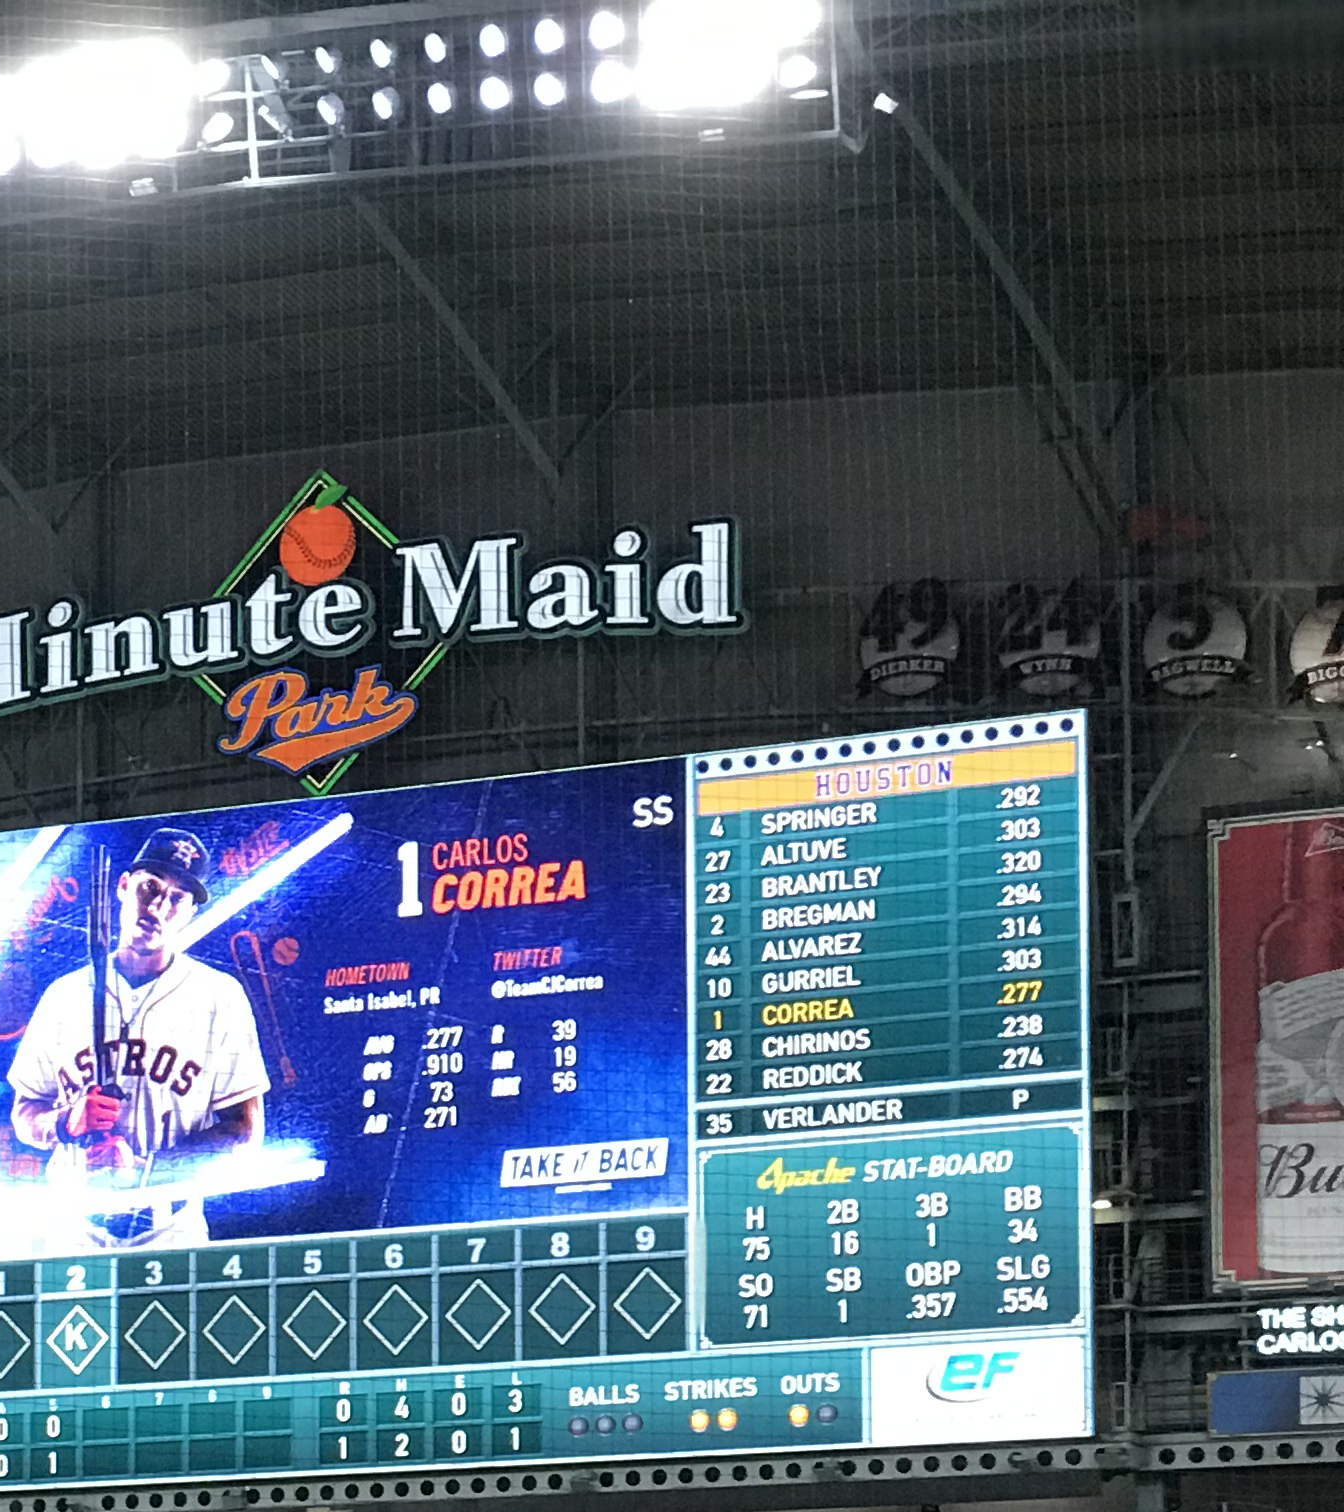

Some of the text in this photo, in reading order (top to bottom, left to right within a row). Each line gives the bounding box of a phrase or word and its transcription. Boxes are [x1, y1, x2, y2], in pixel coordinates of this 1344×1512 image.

[393, 521, 738, 640] Maid
[861, 577, 949, 652] 49
[870, 658, 945, 682] DIERKER
[219, 665, 416, 766] Park
[815, 760, 954, 797] HOUSTON
[633, 795, 673, 828] SS
[761, 802, 877, 835] SPRINGER
[761, 838, 847, 866] ALTUVE
[398, 833, 529, 918] 1 CARLOS
[431, 860, 587, 914] CORREA
[761, 866, 882, 899] BRANTLEY
[761, 899, 876, 931] BREGMAN
[493, 946, 562, 972] TWITTER
[761, 932, 862, 962] ALVAREZ
[325, 962, 410, 987] HOMETOWN
[762, 965, 862, 994] GURRIEL
[324, 995, 363, 1014] Santa
[420, 986, 440, 1006] PR
[713, 980, 1043, 1030] 1 CORREA .277
[762, 1028, 871, 1059] CHIRINOS
[58, 1038, 202, 1098] ASTROS
[763, 1061, 863, 1090] REDDICK
[763, 1097, 904, 1130] VERLANDER
[511, 1152, 564, 1180] TAKE
[599, 1144, 658, 1173] BACK
[757, 1149, 1014, 1196] Apache STAT-BOARD
[1257, 1307, 1305, 1329] THE
[568, 1371, 841, 1408] BALLS STRIKES OUTS
